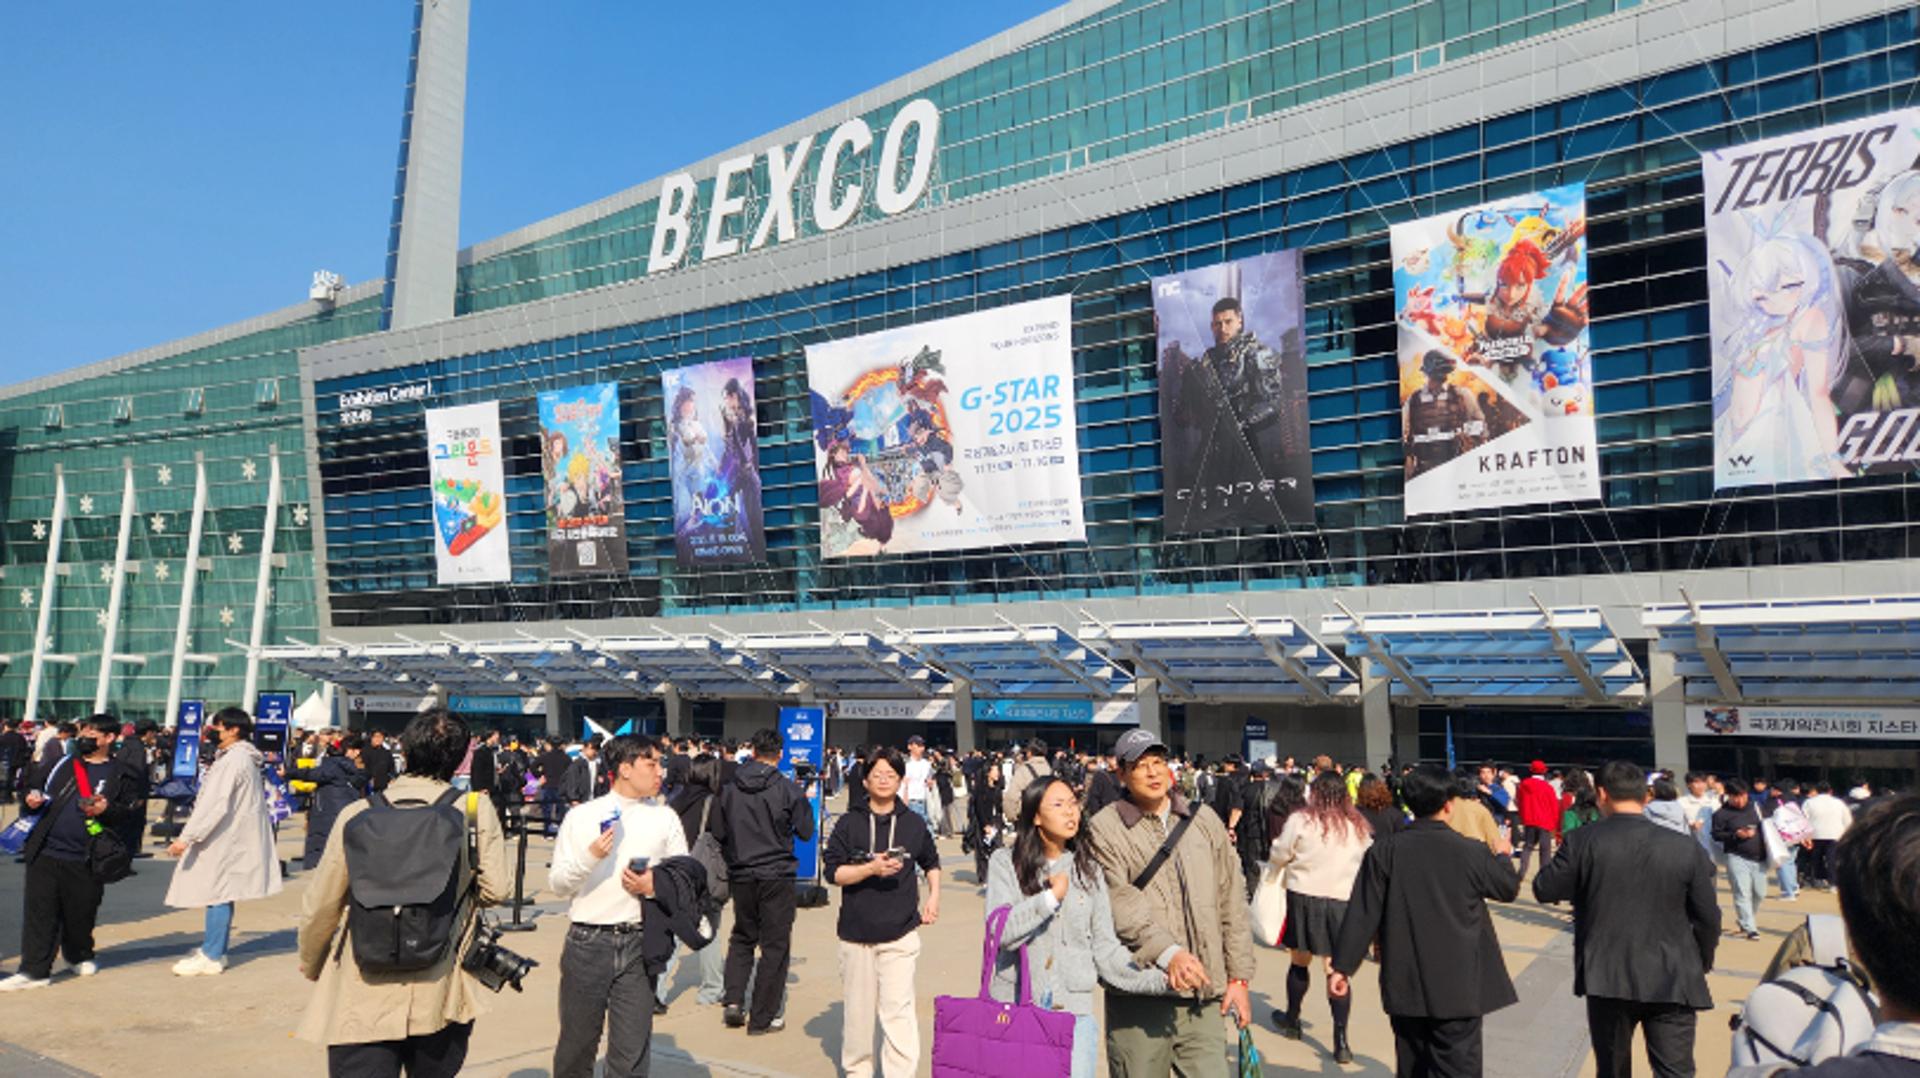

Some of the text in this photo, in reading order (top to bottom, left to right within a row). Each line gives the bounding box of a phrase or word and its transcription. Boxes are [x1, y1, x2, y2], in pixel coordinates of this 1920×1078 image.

[1711, 123, 1898, 215] TERBIS
[647, 98, 941, 274] BEXCO
[390, 384, 427, 401] Center
[960, 375, 1060, 411] G-STAR
[988, 404, 1062, 436] 2025
[434, 438, 493, 467] 그라운드
[1479, 446, 1585, 473] KRAFTON
[1749, 717, 1918, 734] 국제게임전시회 지스타
